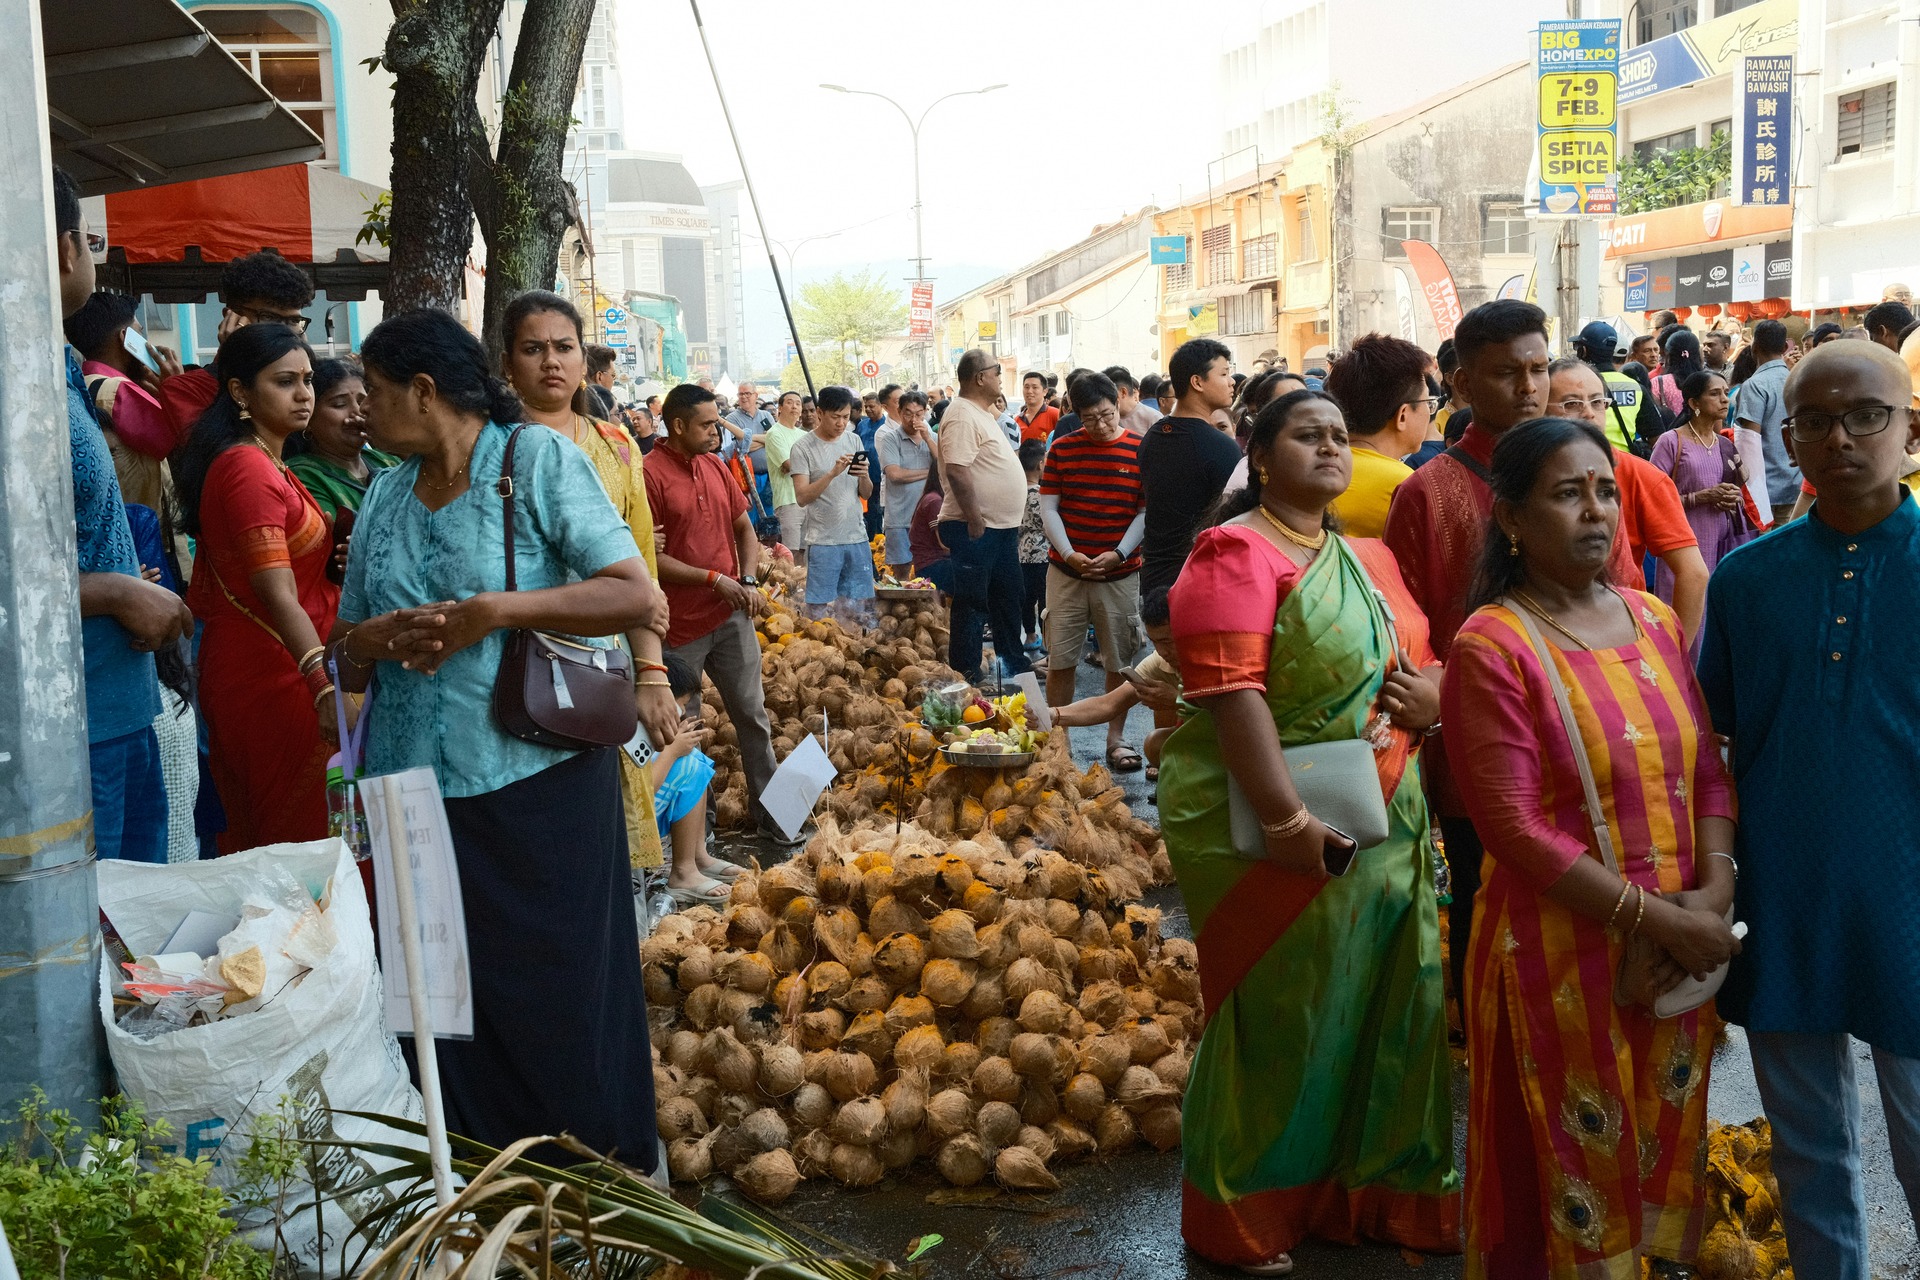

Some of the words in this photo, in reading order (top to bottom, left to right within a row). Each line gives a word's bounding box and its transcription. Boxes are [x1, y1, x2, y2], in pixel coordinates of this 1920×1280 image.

[1541, 23, 1565, 31] PAMERAN
[1565, 21, 1593, 30] BARANGAN
[1593, 21, 1620, 29] KEDIAMAN
[1541, 31, 1580, 49] BIG
[1540, 48, 1616, 62] HOMEXPO
[1746, 59, 1791, 70] RAWATAN
[1619, 60, 1650, 87] SHOEI
[1746, 71, 1790, 81] PENYAKIT
[1557, 78, 1598, 97] 7-9
[1617, 90, 1636, 101] EMIUM
[1635, 84, 1658, 96] HELMETS
[1747, 82, 1789, 93] BAWASIR
[1557, 100, 1604, 116] FEB.
[1755, 98, 1777, 182] 謝氏診所
[1548, 141, 1608, 156] SETIA
[1548, 160, 1608, 175] SPICE
[649, 216, 675, 226] TIMES
[677, 217, 708, 229] SQUARE
[1600, 223, 1646, 248] UCATI
[1770, 260, 1791, 274] SHOEI
[1737, 271, 1759, 284] cardo
[1612, 390, 1636, 405] LIS
